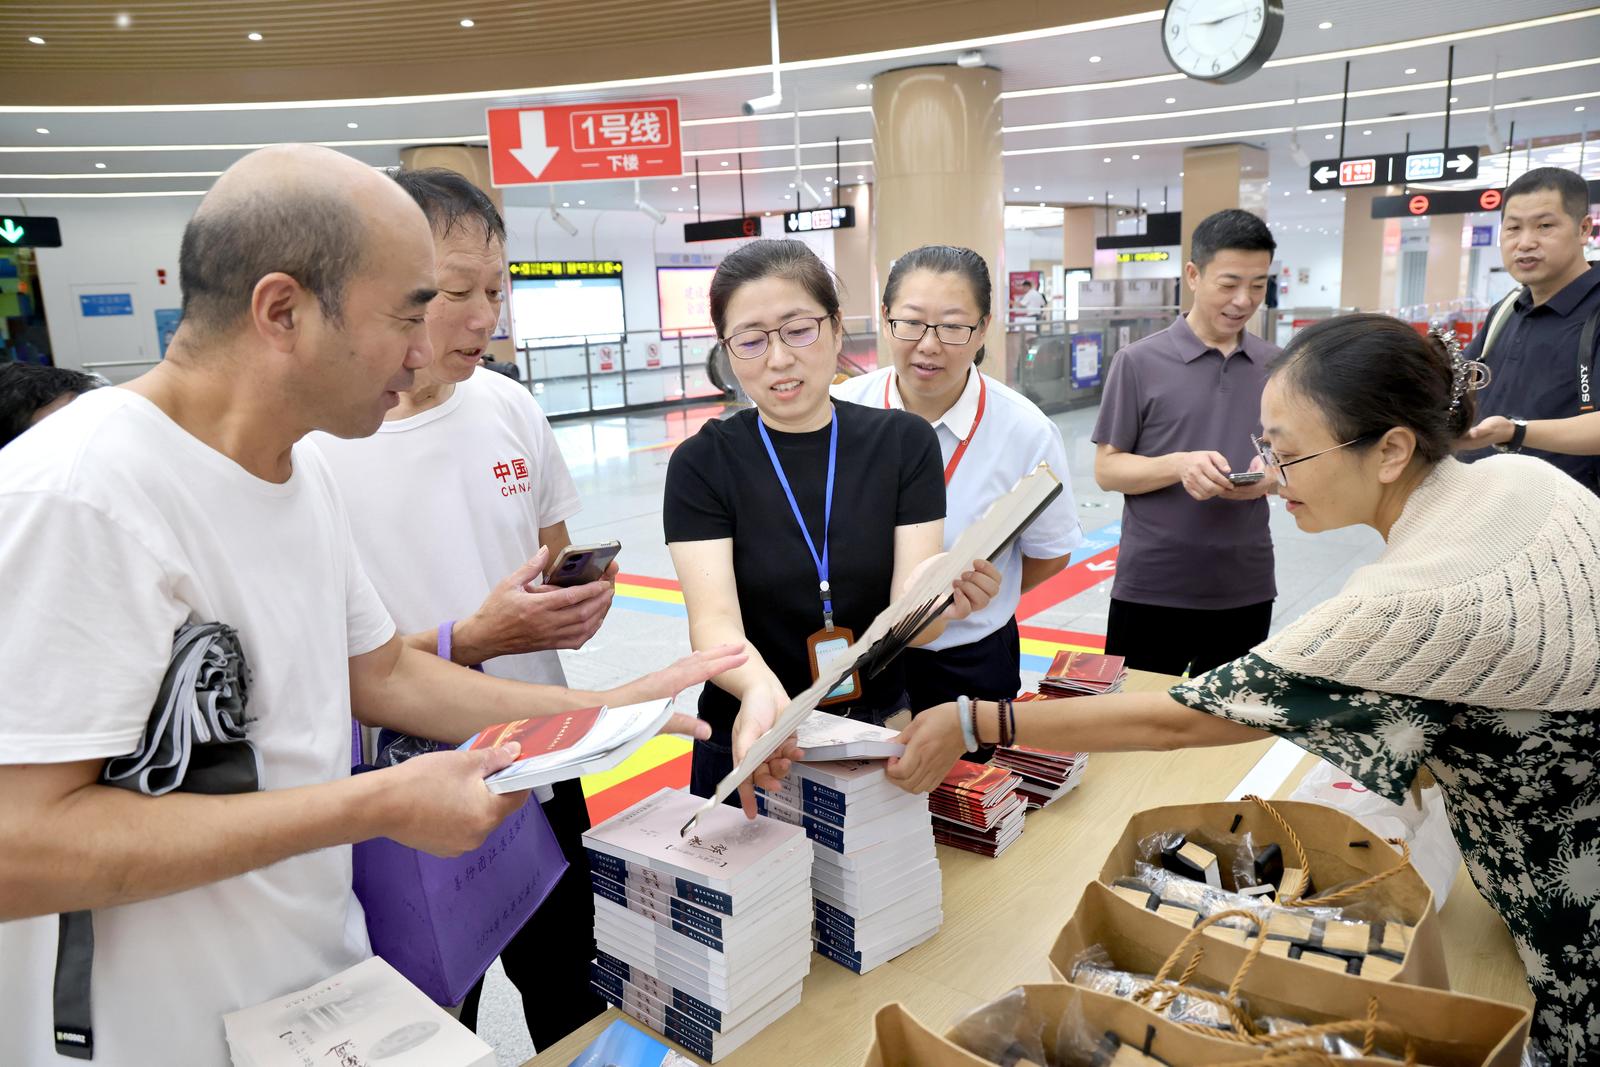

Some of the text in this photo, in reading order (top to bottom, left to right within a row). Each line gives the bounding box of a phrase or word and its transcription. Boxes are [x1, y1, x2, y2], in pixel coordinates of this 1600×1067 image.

[1252, 7, 1262, 23] 3
[1171, 24, 1180, 39] 9
[1211, 57, 1221, 74] 6
[581, 112, 662, 146] 1号线
[607, 154, 640, 172] 下楼
[1580, 364, 1590, 402] SONY
[493, 459, 528, 483] 中国
